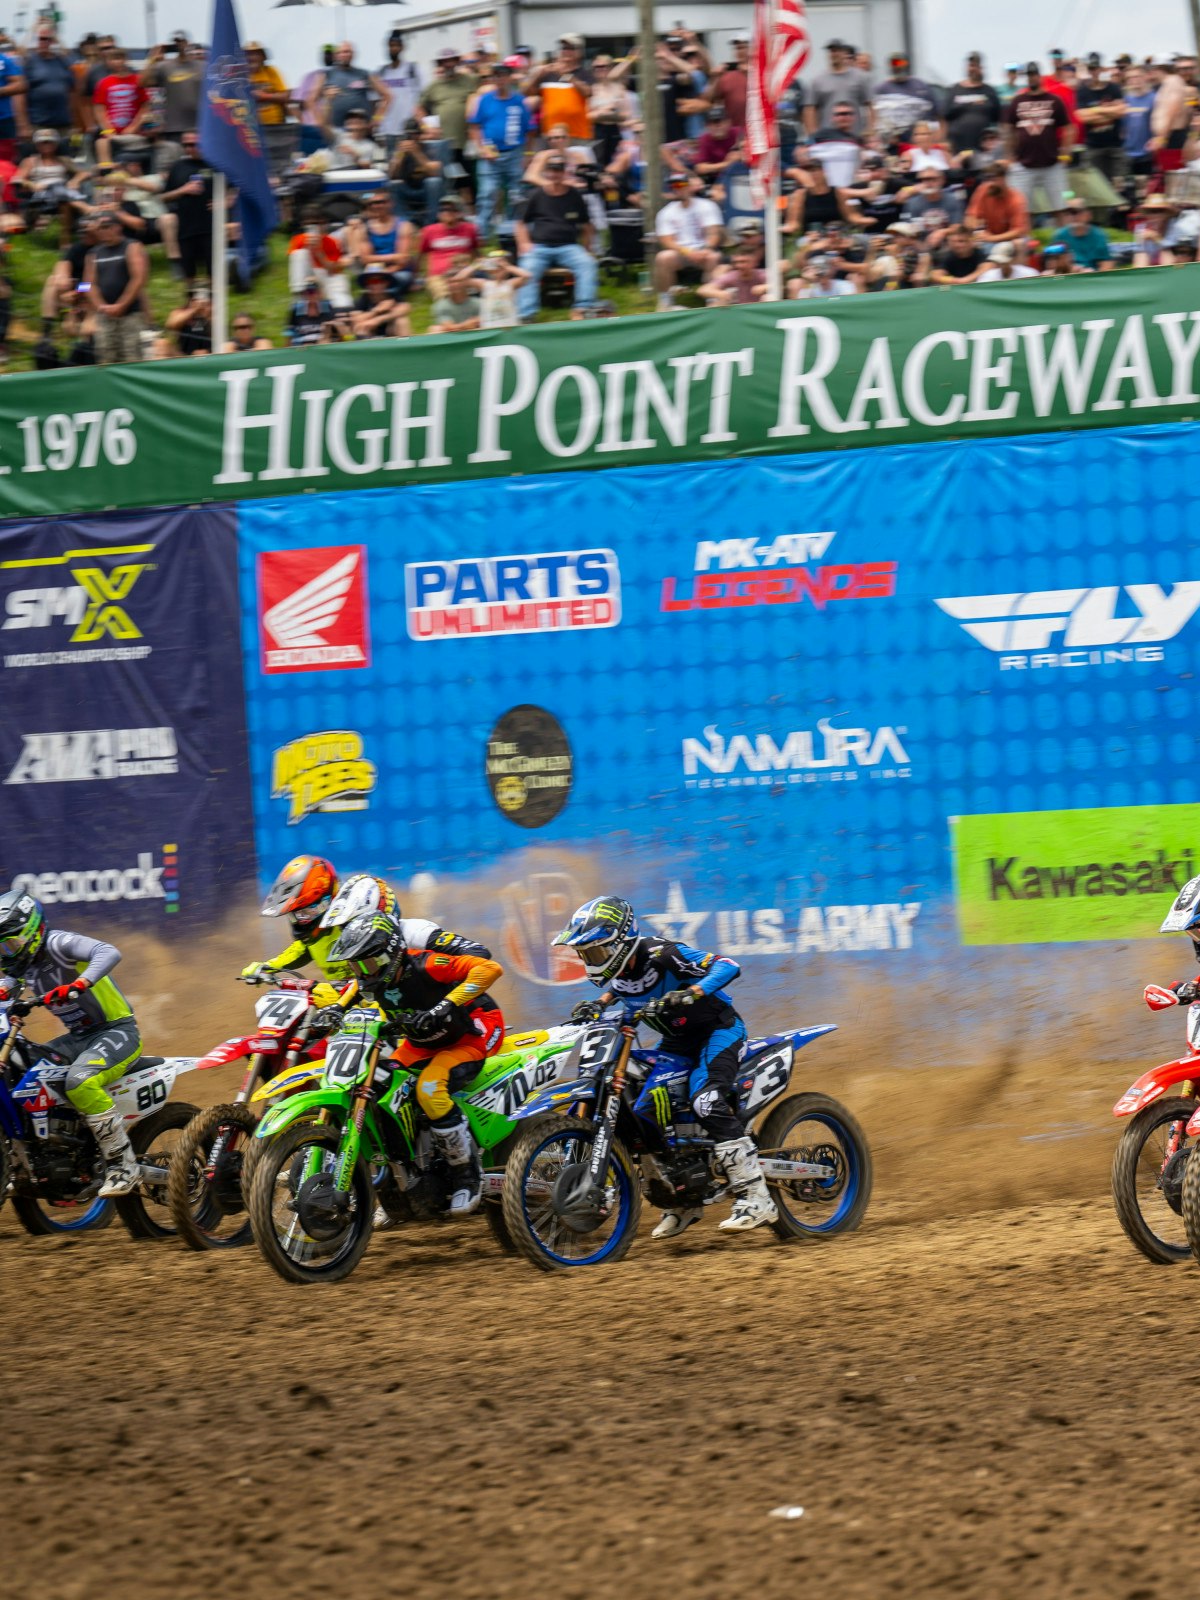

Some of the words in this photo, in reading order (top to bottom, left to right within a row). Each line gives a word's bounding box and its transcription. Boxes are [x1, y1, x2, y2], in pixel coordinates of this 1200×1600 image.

[17, 408, 137, 473] 1976
[213, 364, 455, 485] HIGH
[467, 345, 755, 464] POINT
[415, 552, 611, 605] PARTS
[659, 561, 899, 612] LEGENDS
[1, 564, 147, 642] SMX
[415, 595, 616, 638] UNLIMITED
[1000, 646, 1164, 671] RACING
[682, 717, 911, 775] NAMURA
[684, 771, 858, 789] TECHNOLOGIES
[985, 847, 1195, 901] Kawasaki
[388, 933, 400, 953] FOX
[715, 908, 795, 956] U.S.
[796, 901, 921, 954] ARMY
[258, 997, 300, 1026] 74
[430, 999, 448, 1016] FOX
[93, 1029, 130, 1058] FLY
[326, 1042, 367, 1078] 70
[581, 1030, 614, 1067] 3
[137, 1079, 167, 1112] 80
[493, 1070, 530, 1116] 70
[761, 1055, 788, 1096] 3
[341, 1145, 353, 1191] DUNLOP
[591, 1126, 605, 1174] DUNLOP
